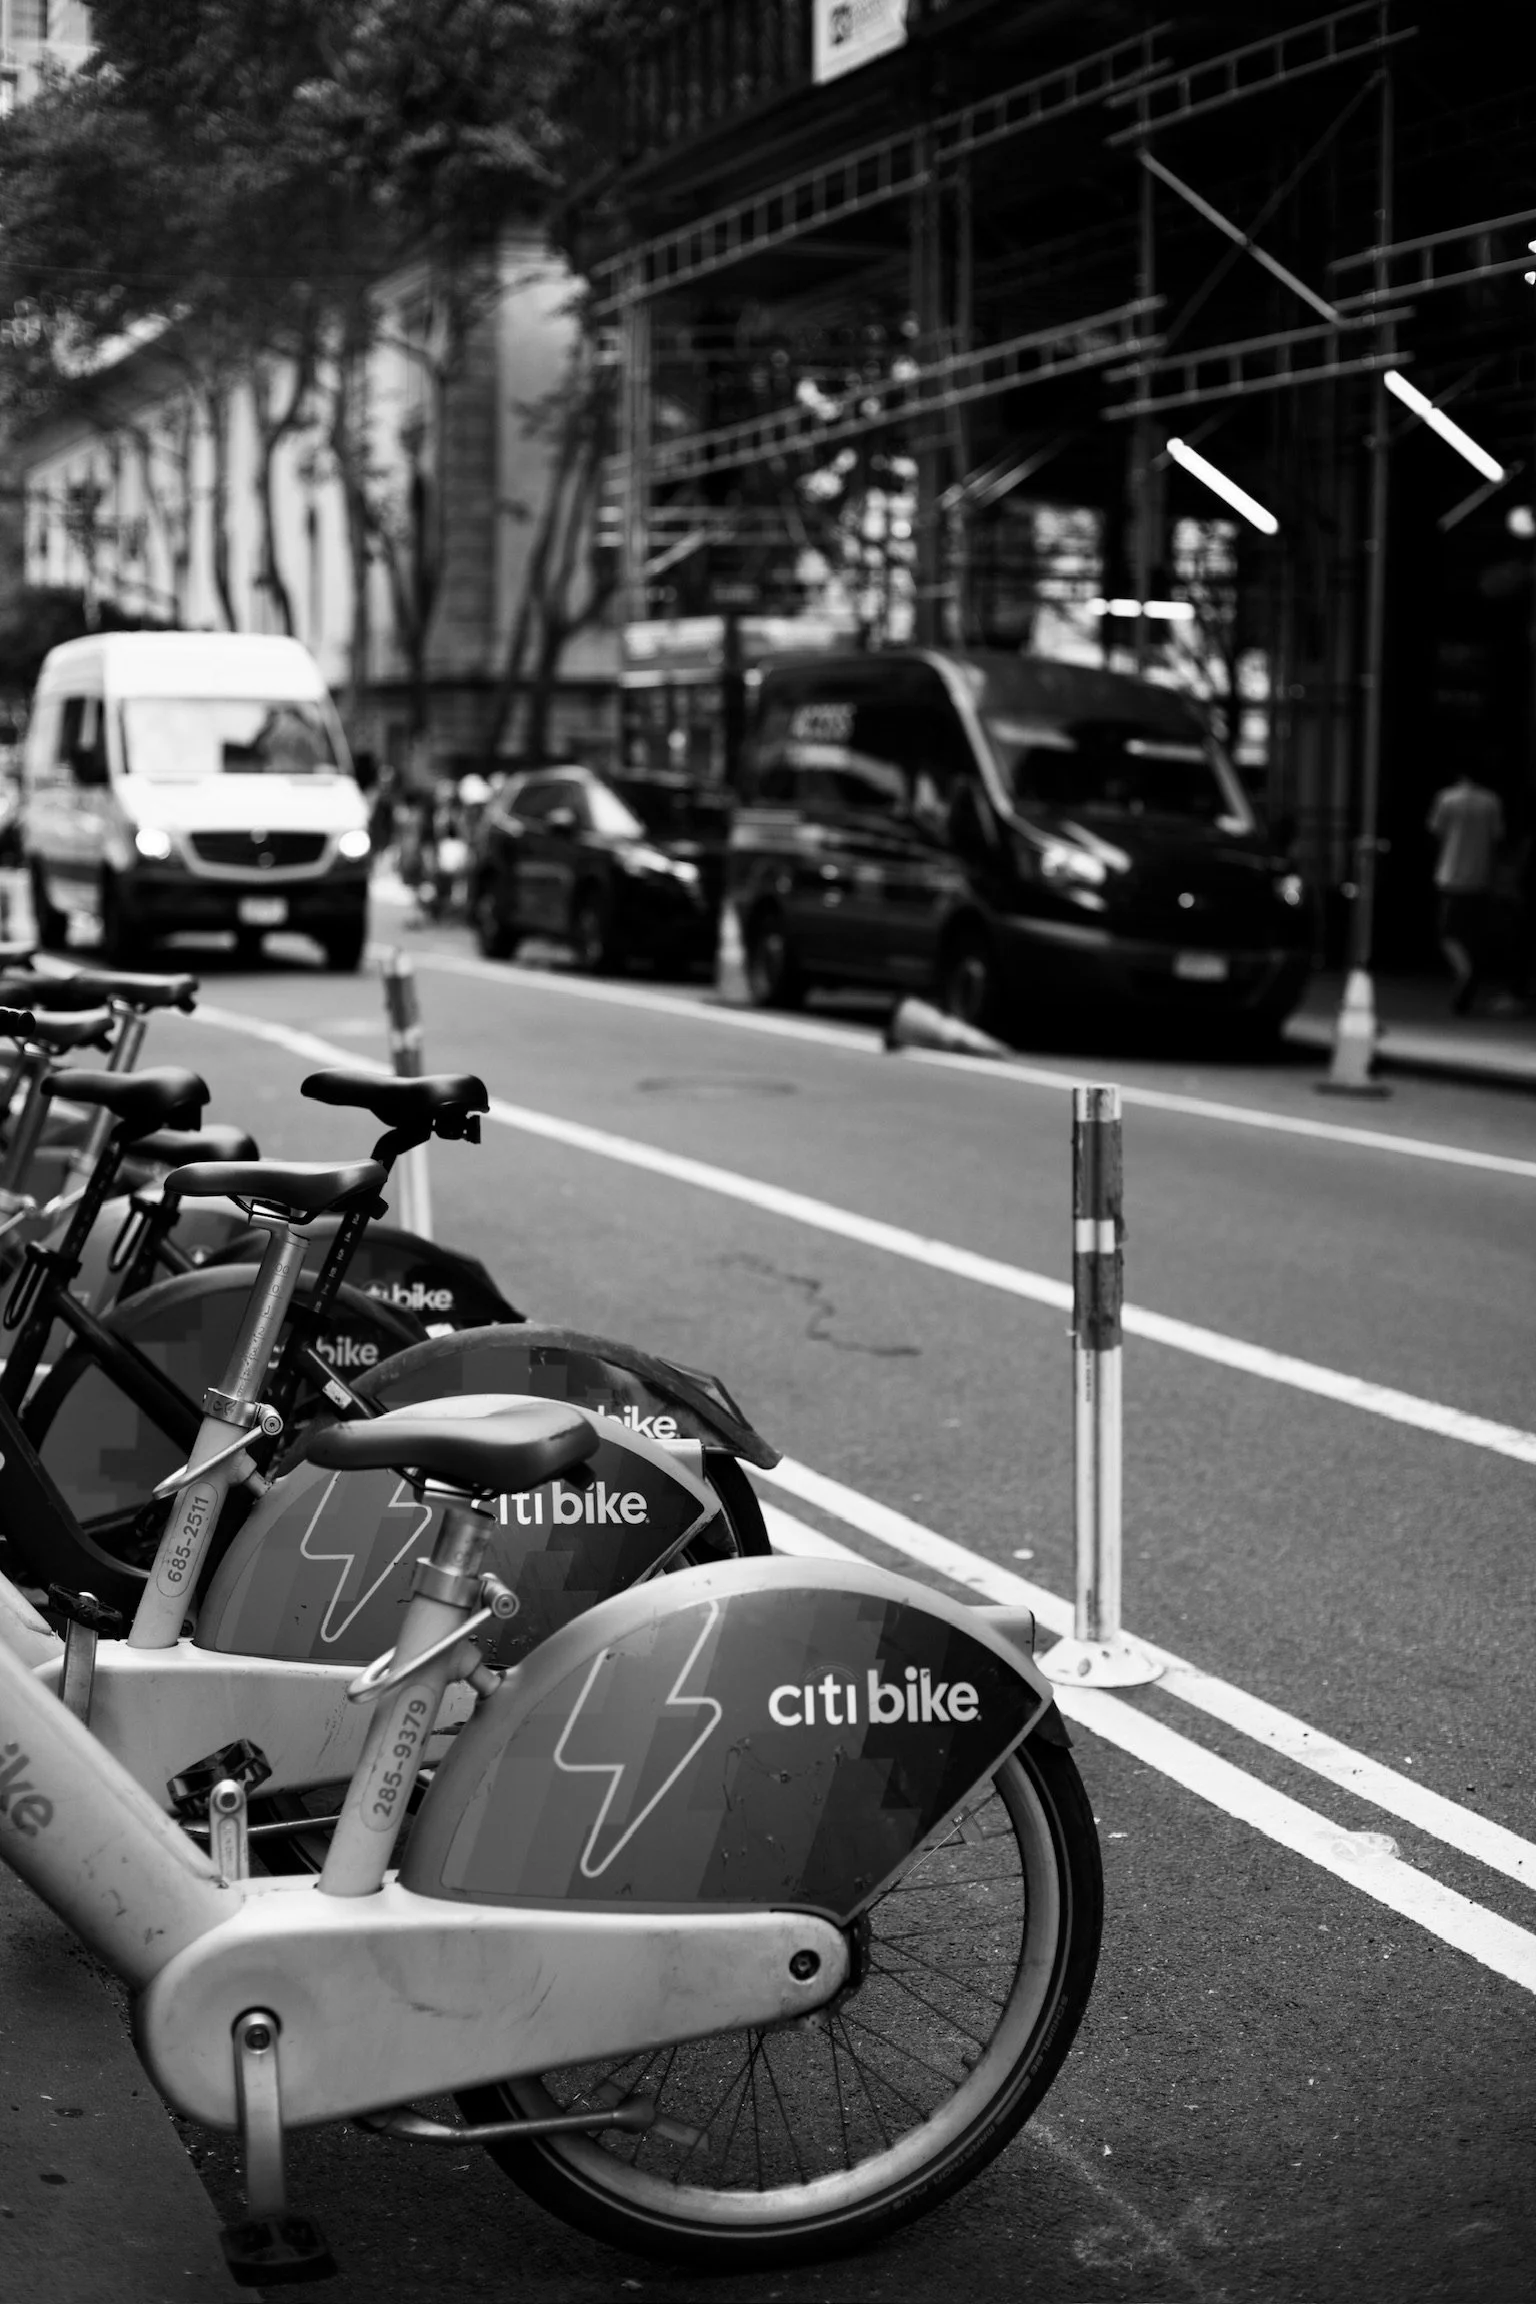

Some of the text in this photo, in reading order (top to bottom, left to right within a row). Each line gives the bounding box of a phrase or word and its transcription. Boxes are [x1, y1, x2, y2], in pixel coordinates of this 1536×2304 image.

[392, 1282, 453, 1311] bike
[471, 1481, 648, 1525] iti bike
[167, 1496, 209, 1582] 685-2511
[768, 1666, 980, 1726] citi bike
[373, 1700, 427, 1817] 285-9379
